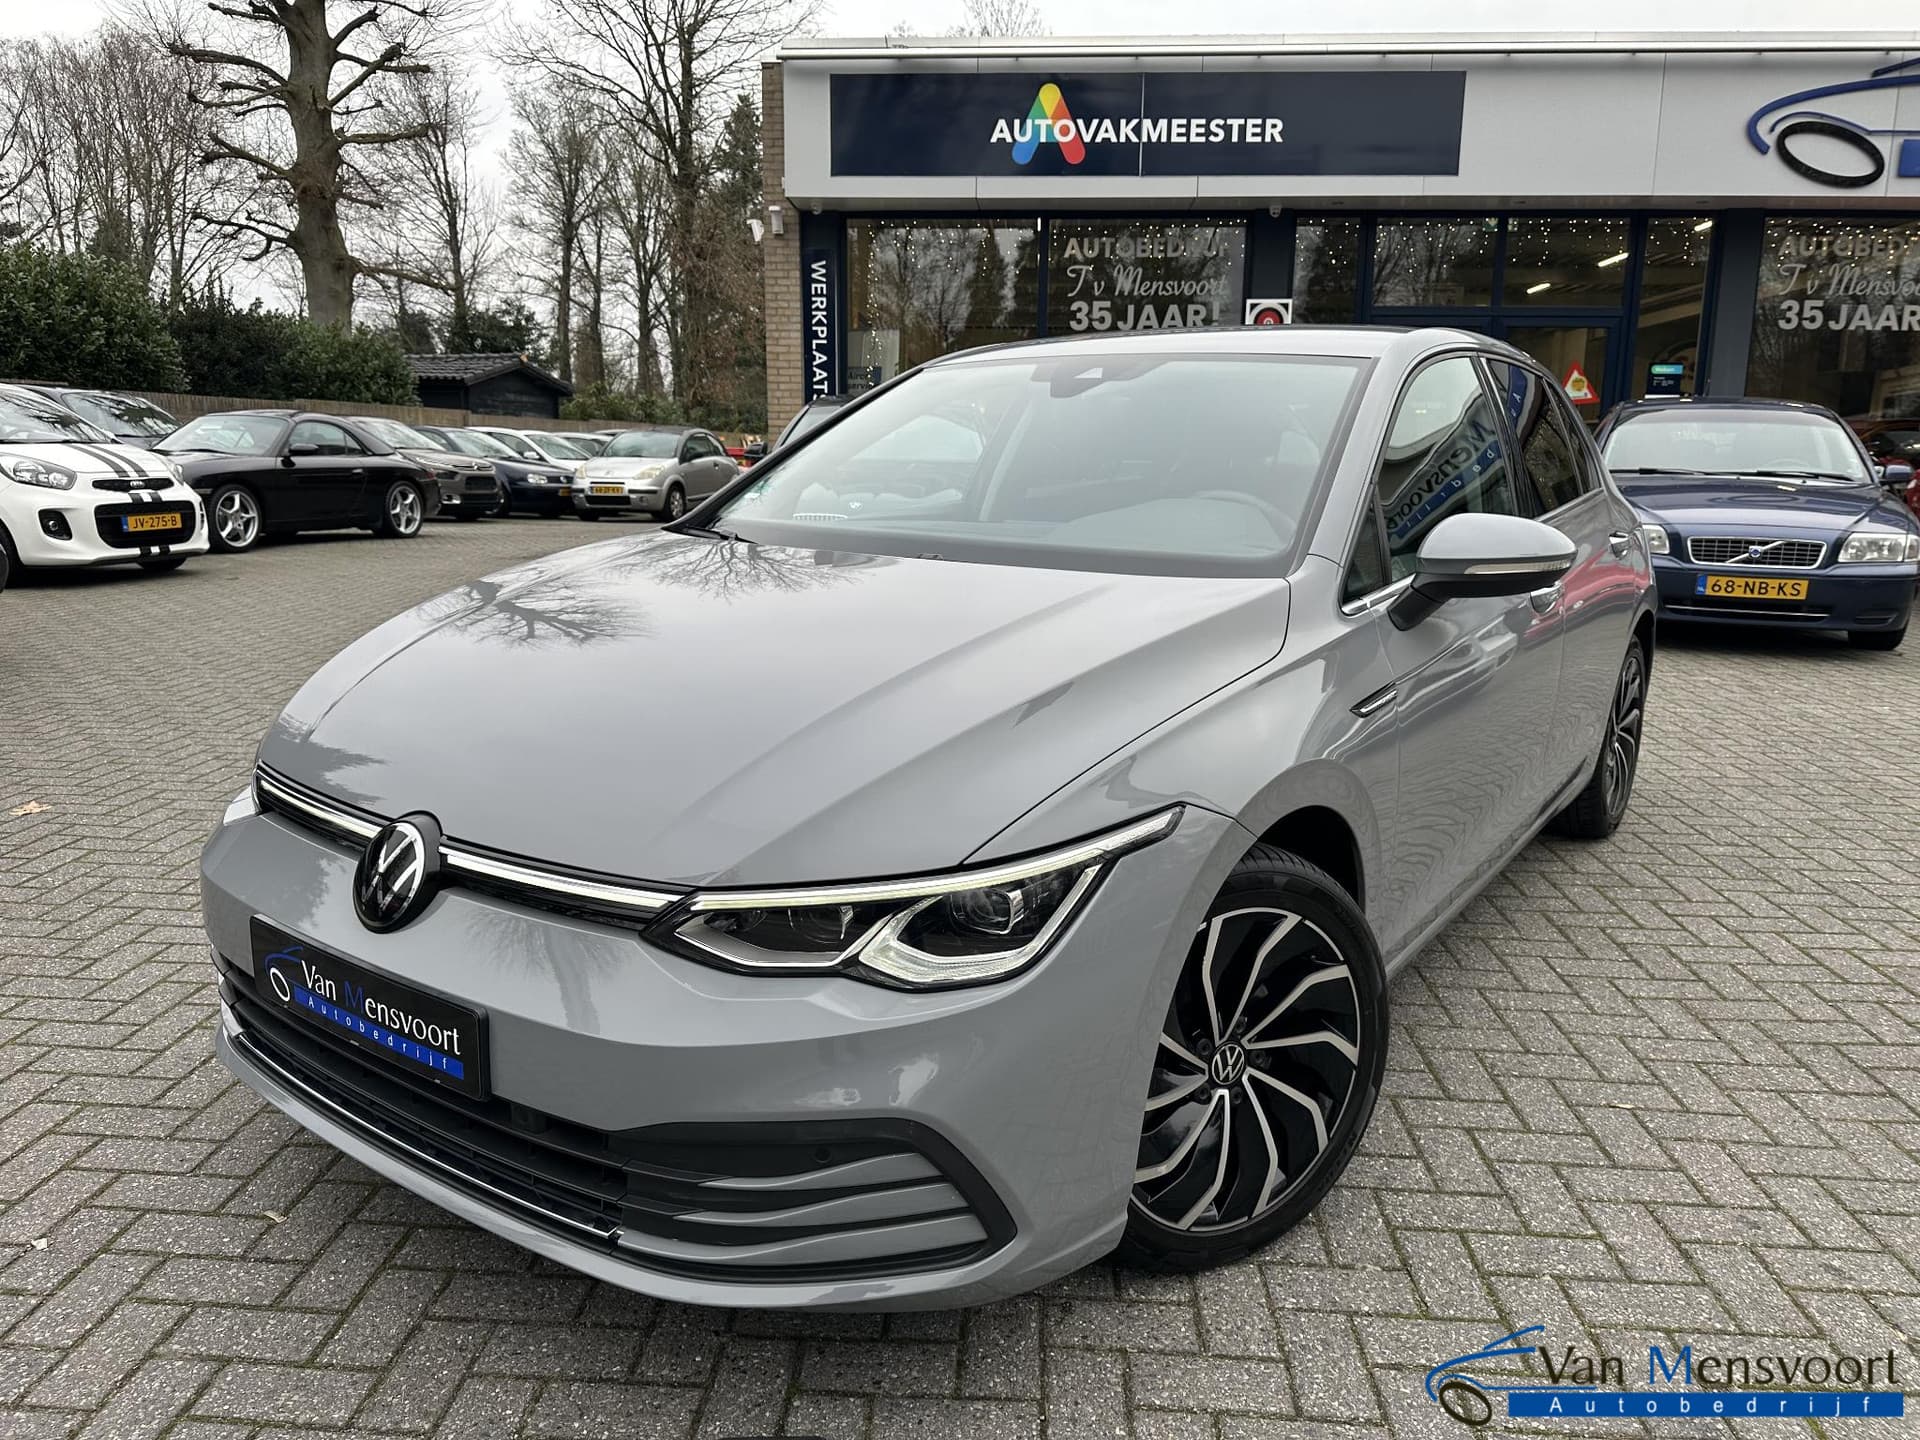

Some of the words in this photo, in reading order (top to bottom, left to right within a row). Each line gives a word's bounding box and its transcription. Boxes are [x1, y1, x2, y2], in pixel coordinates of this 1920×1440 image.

[990, 118, 1284, 143] AUTOVAKMEESTER
[1064, 237, 1225, 258] AUTOBEDJF
[1778, 235, 1920, 257] AUTOBED
[1113, 263, 1230, 296] Mensvoort
[1069, 301, 1112, 331] 35
[1778, 299, 1824, 330] 35
[132, 515, 178, 529] JV-275-B
[1711, 579, 1802, 597] 68-NB-KS
[301, 959, 337, 1001] Van
[343, 980, 461, 1055] Mensvoort
[308, 996, 448, 1069] Autobedrijf
